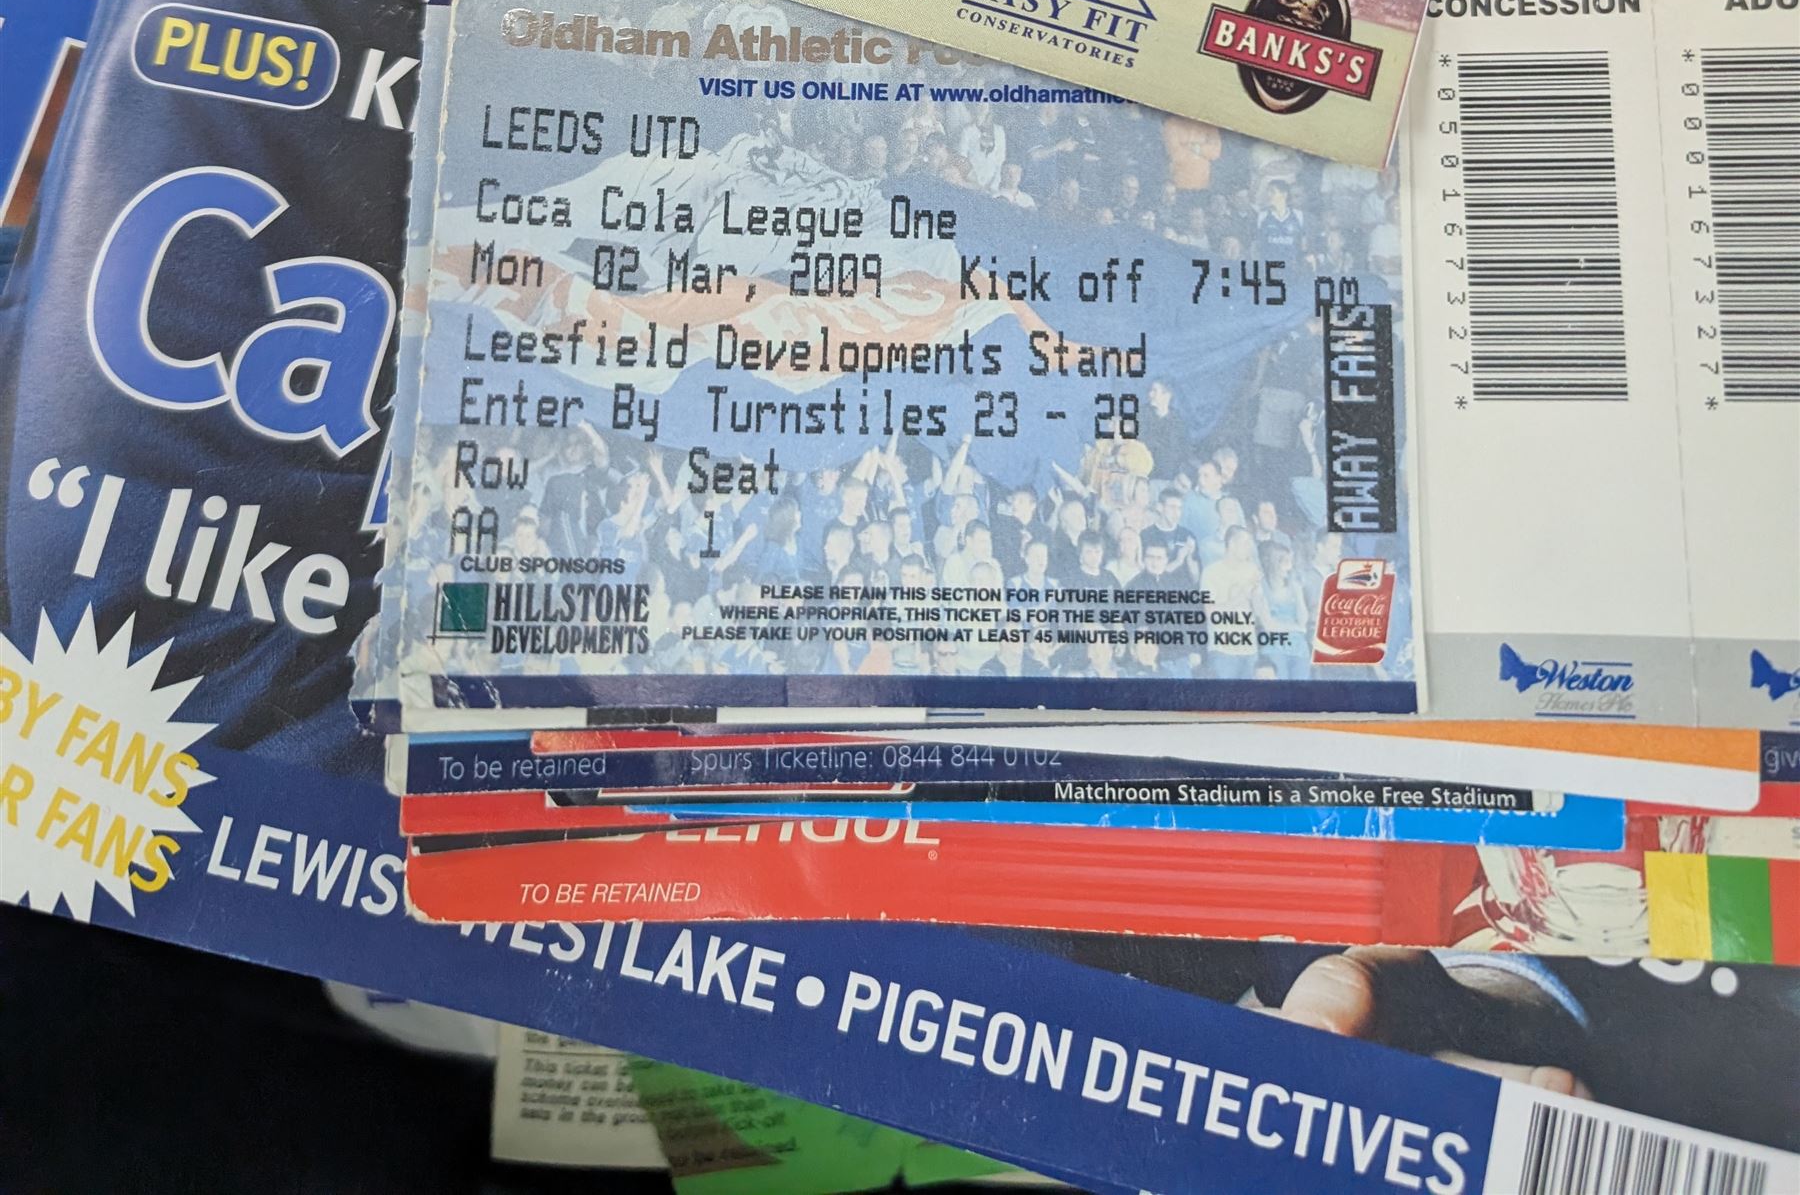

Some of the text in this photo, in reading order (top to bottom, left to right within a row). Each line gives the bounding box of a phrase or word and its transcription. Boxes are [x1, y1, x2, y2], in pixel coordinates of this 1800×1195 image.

[502, 8, 690, 58] Oldham
[703, 23, 893, 64] Athletic
[956, 7, 1135, 68] CONSERVATORIES
[1084, 9, 1148, 44] FIT
[154, 15, 317, 92] PLUS!
[1213, 18, 1367, 86] BANKS'S
[700, 77, 889, 102] VISIT ONLINE
[482, 104, 699, 159] LEEDS UTD
[477, 178, 956, 246] Coca Cola League One
[471, 240, 1286, 305] Mon 2009 Kick off 7:45
[464, 313, 1146, 384] Leesfield Developments Stand
[460, 377, 1139, 442] Enter By Turnstiles 23 28
[1330, 305, 1379, 531] AWAY FANS
[454, 439, 529, 491] Row
[687, 446, 779, 495] Seat
[146, 488, 350, 635] like
[460, 555, 626, 575] CLUB SPONSORS
[493, 582, 650, 623] HILLSTONE
[719, 605, 1206, 626] WHERE THIS TICKET SEAT STATED
[760, 585, 1110, 604] PLEASE RETAIN THIS SECTION FUTURE
[490, 624, 649, 655] DEVELOPMENTS
[681, 627, 1252, 646] PLEASE TAKE YOUR POSITION LEAST MINUTES PRIOR KICK
[1322, 626, 1382, 640] LEAGUE
[1324, 617, 1382, 628] FOOTBALL
[1537, 660, 1634, 692] Weston
[56, 704, 200, 808] FANS
[474, 752, 606, 780] be retained
[1054, 782, 1517, 807] Matchroom Stadium Smoke Free Stadium
[36, 786, 181, 893] FANS
[591, 882, 702, 904] RETAINED
[206, 815, 1471, 1195] LEWIS PIGEON DETECTIVES
